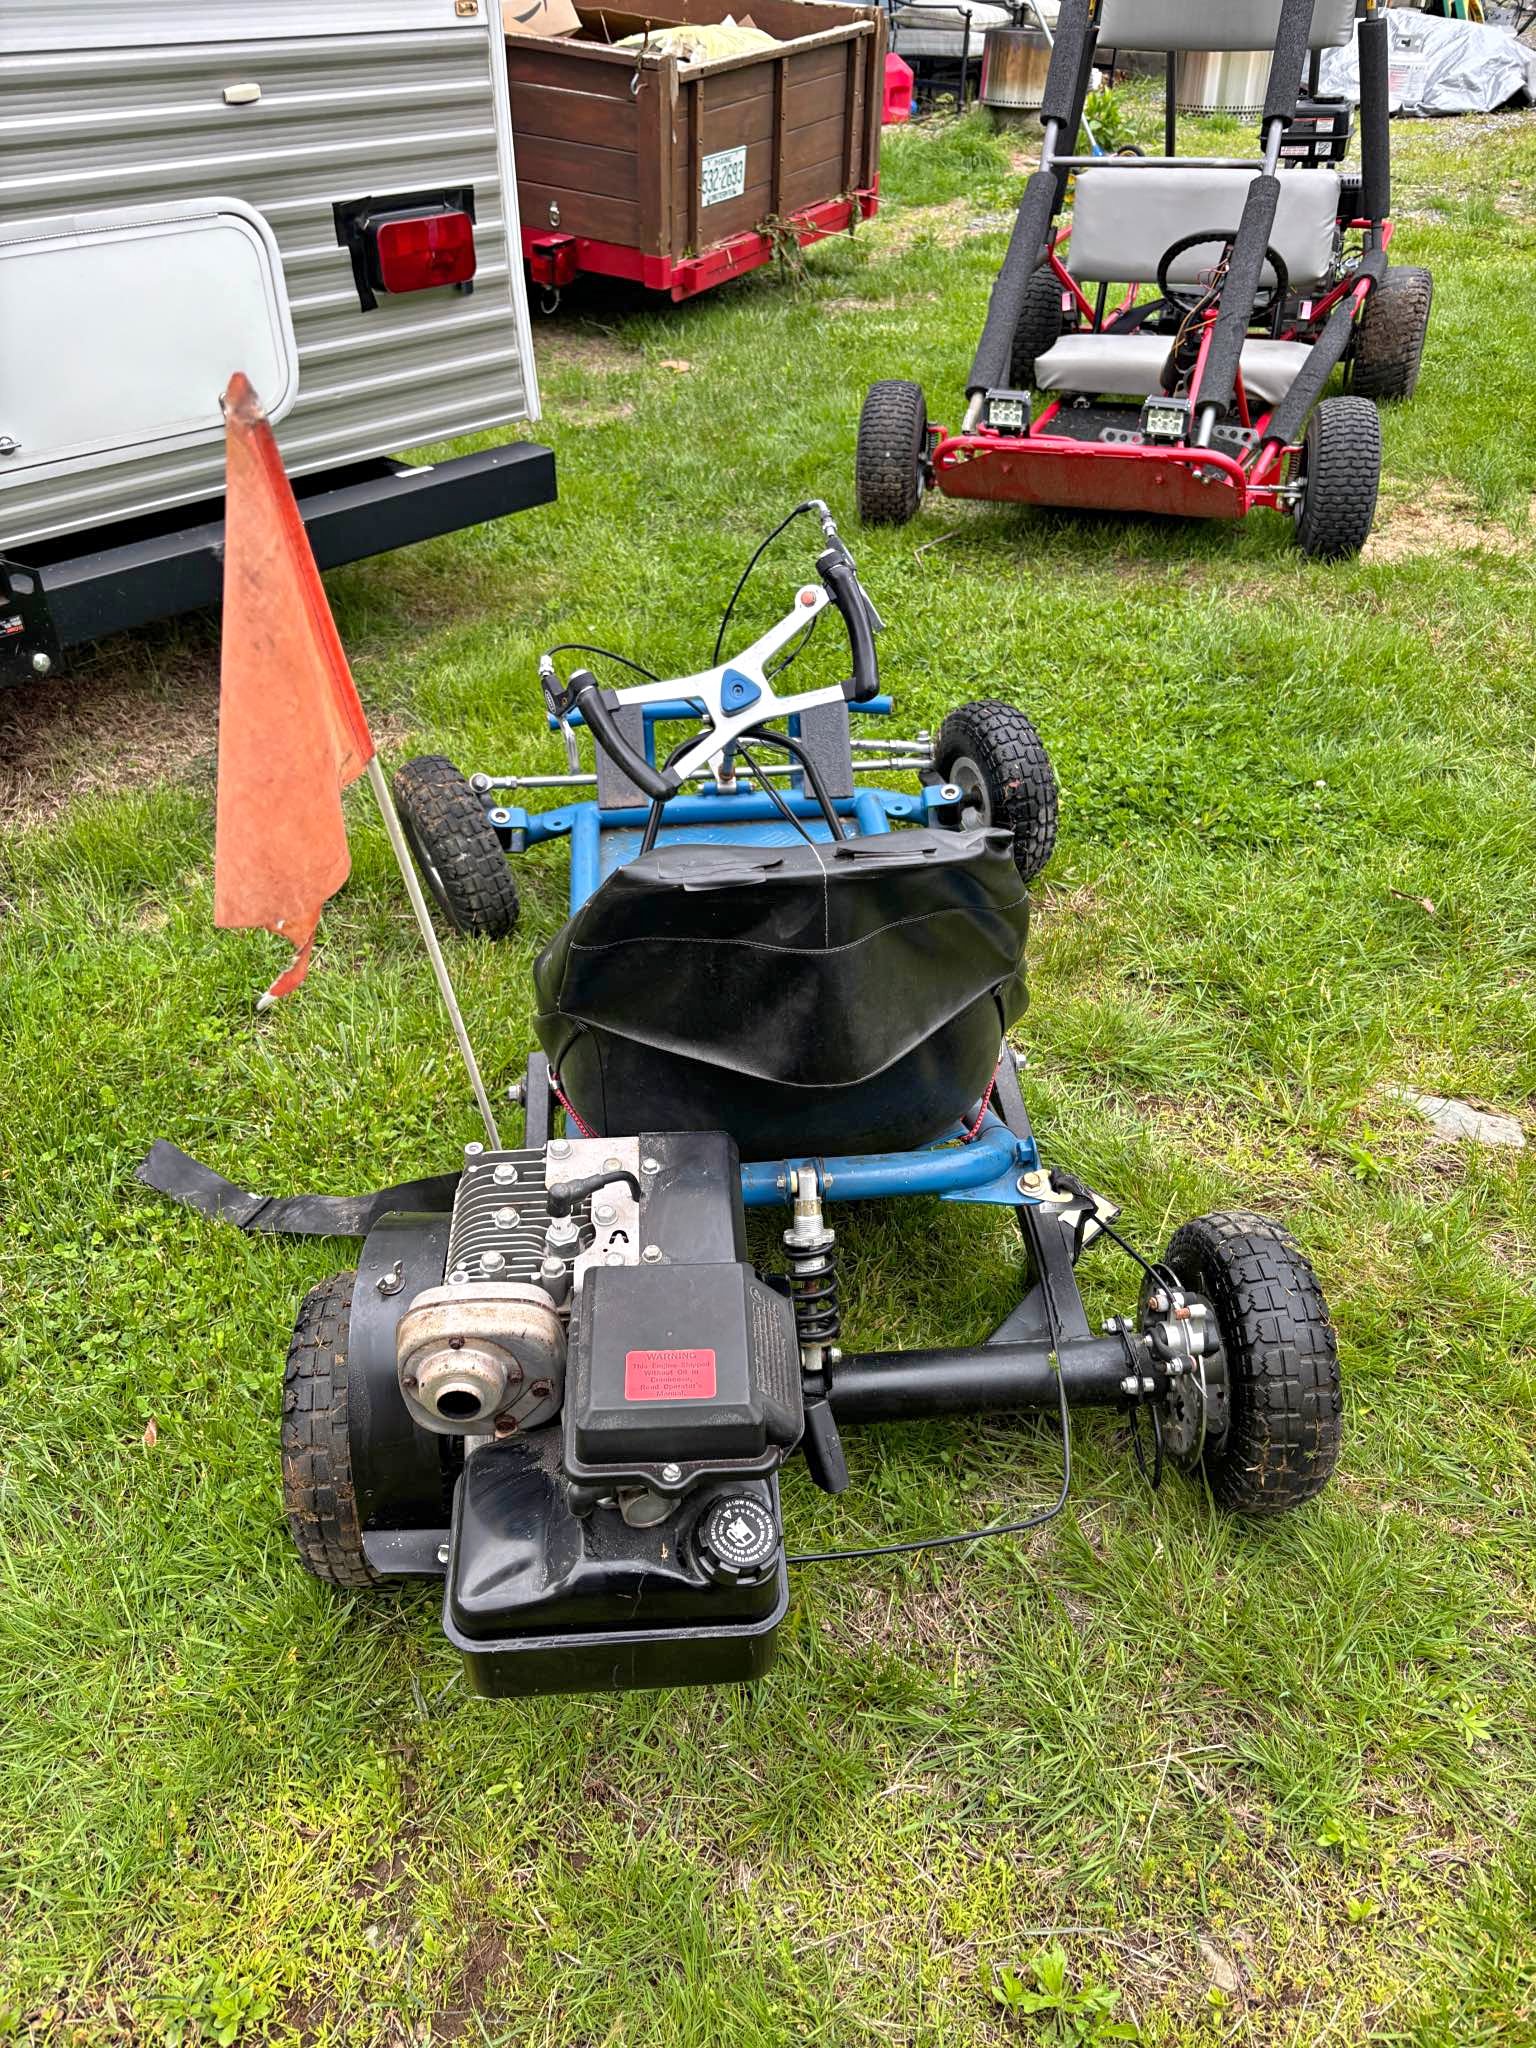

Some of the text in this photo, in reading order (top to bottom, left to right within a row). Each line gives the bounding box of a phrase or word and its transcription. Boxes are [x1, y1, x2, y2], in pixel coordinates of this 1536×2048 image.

[646, 1352, 697, 1361] WARNING
[726, 1500, 745, 1508] ALLOW
[745, 1501, 765, 1516] ENGINE
[756, 1517, 765, 1529] USE
[764, 1515, 771, 1524] TO
[719, 1535, 746, 1556] GASOLINE
[746, 1530, 765, 1555] UNLEADED
[762, 1540, 771, 1553] FOR
[713, 1540, 733, 1559] BEFORE
[733, 1553, 760, 1563] MINUTES
